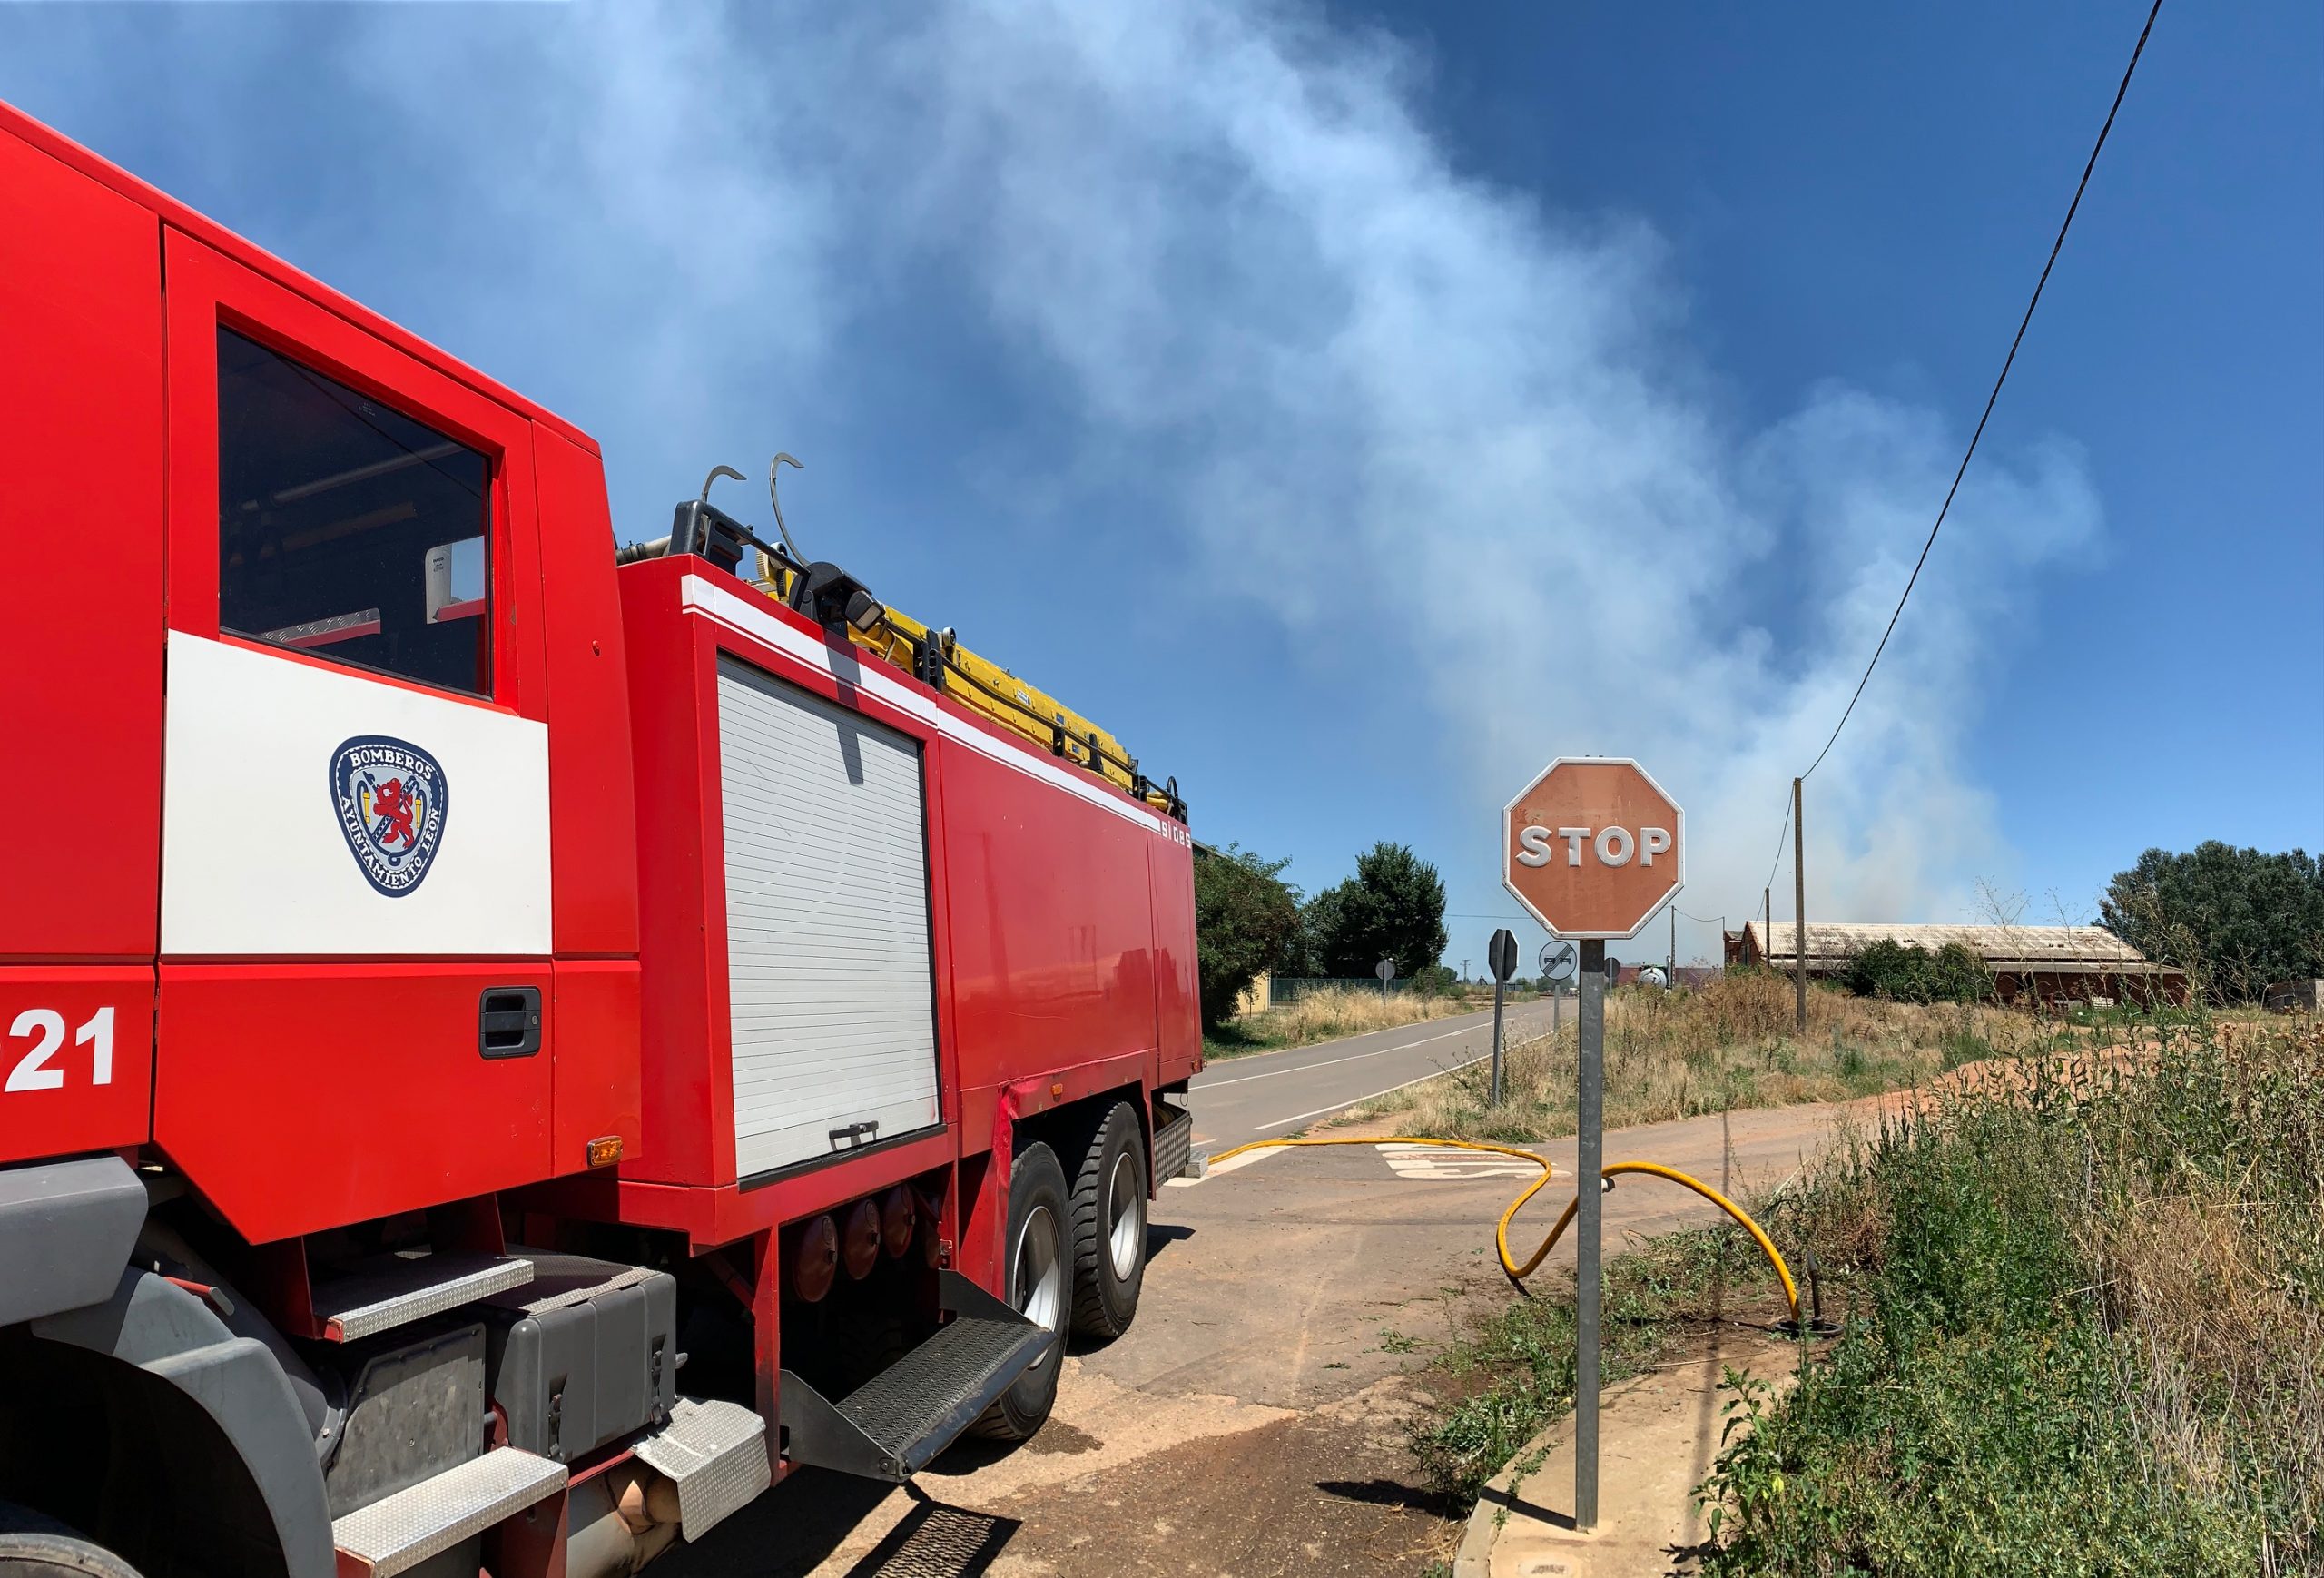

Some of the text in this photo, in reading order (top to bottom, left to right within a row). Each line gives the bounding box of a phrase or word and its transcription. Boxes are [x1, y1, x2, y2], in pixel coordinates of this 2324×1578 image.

[350, 749, 435, 781] BOMBEROS
[341, 796, 439, 886] AYUNTAMIENTO LEON
[1161, 820, 1191, 849] sides
[1515, 825, 1672, 868] STOP
[5, 1006, 115, 1092] 21
